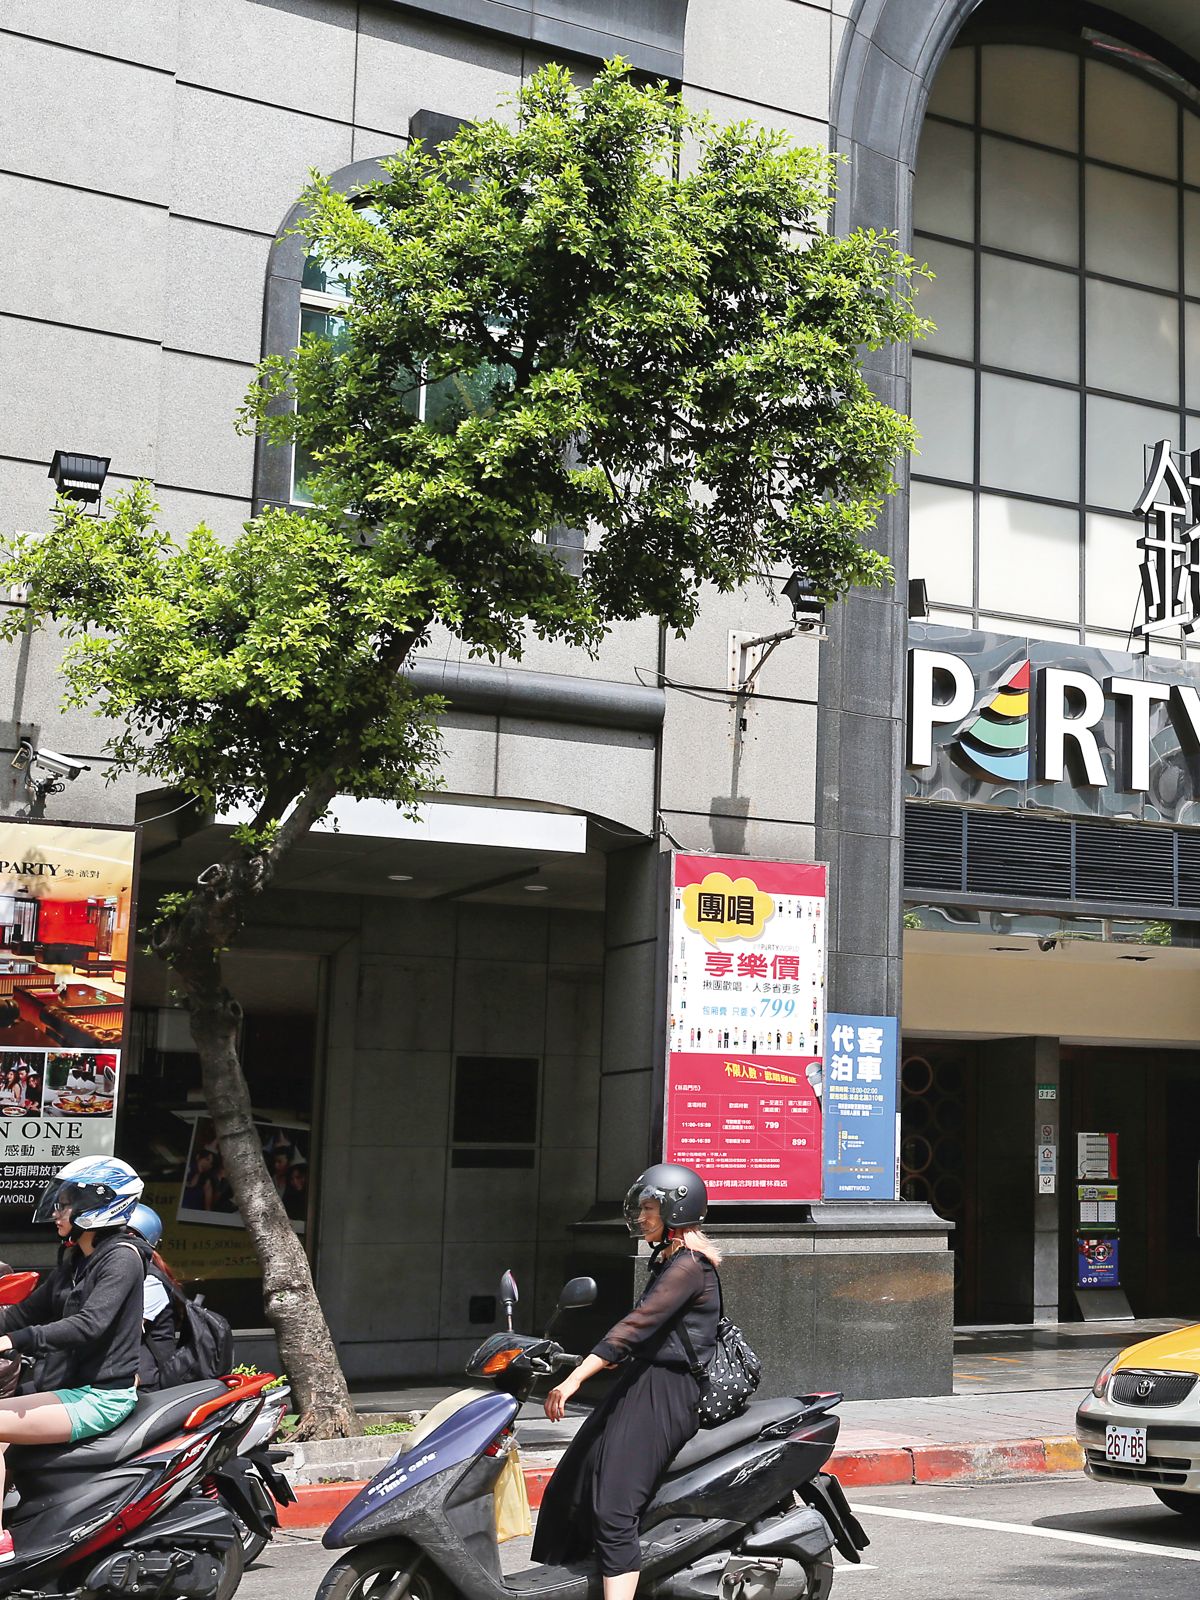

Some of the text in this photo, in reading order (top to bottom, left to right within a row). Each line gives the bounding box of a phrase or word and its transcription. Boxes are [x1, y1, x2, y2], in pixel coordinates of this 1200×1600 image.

[0, 861, 60, 876] PARTY
[697, 892, 755, 926] 團唱
[704, 951, 801, 981] 享樂價
[752, 982, 801, 995] 人多省更多
[831, 1024, 883, 1054] 代客
[830, 1053, 882, 1083] 泊車
[1039, 1089, 1056, 1098] 312
[21, 1121, 83, 1139] ONE
[764, 1121, 780, 1130] 799
[791, 1138, 807, 1147] 899
[0, 1164, 63, 1177] 包廂開放訂
[1107, 1433, 1144, 1459] 267-B5
